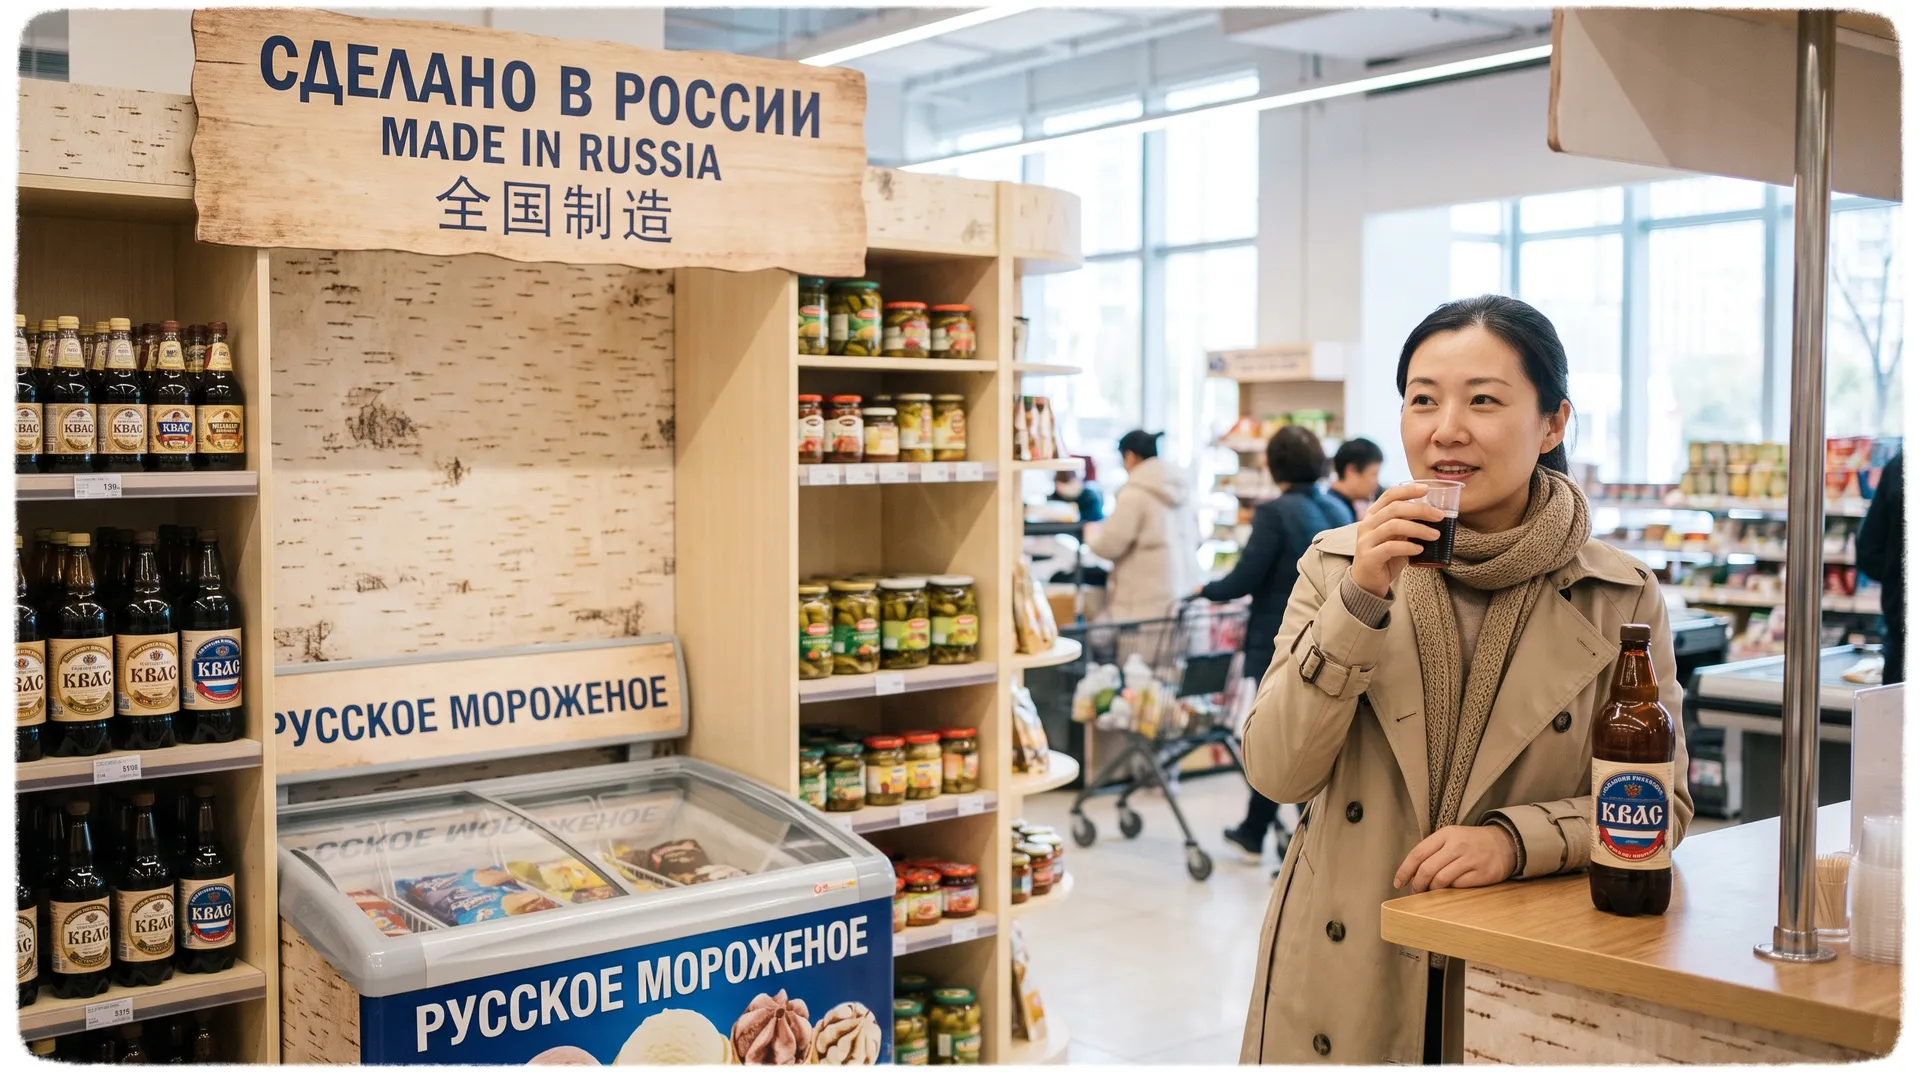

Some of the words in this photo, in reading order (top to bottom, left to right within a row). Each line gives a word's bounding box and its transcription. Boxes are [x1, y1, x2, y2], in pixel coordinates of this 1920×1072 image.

[260, 35, 535, 112] СДЕЛАНО
[560, 66, 592, 116] В
[615, 72, 821, 138] РОССИИ
[382, 117, 505, 165] MADE
[523, 129, 561, 169] IN
[580, 134, 722, 181] RUSSIA
[436, 175, 672, 243] 全国制造
[17, 424, 39, 433] ВАС
[64, 424, 94, 433] КВАС
[113, 424, 143, 433] КВАС
[163, 423, 190, 432] КВАС
[130, 665, 176, 683] КВАС
[197, 660, 240, 677] КВАС
[16, 675, 43, 692] ВАС
[62, 670, 111, 688] КВАС
[451, 675, 668, 729] МОРОЖЕНОЕ
[1601, 802, 1663, 825] КВАС
[192, 903, 232, 920] КВАС
[135, 914, 174, 933] КВАС
[68, 925, 108, 945] КВАС
[416, 965, 623, 1052] РУССКОЕ
[637, 915, 868, 1004] МОРОЖЕНОЕ
